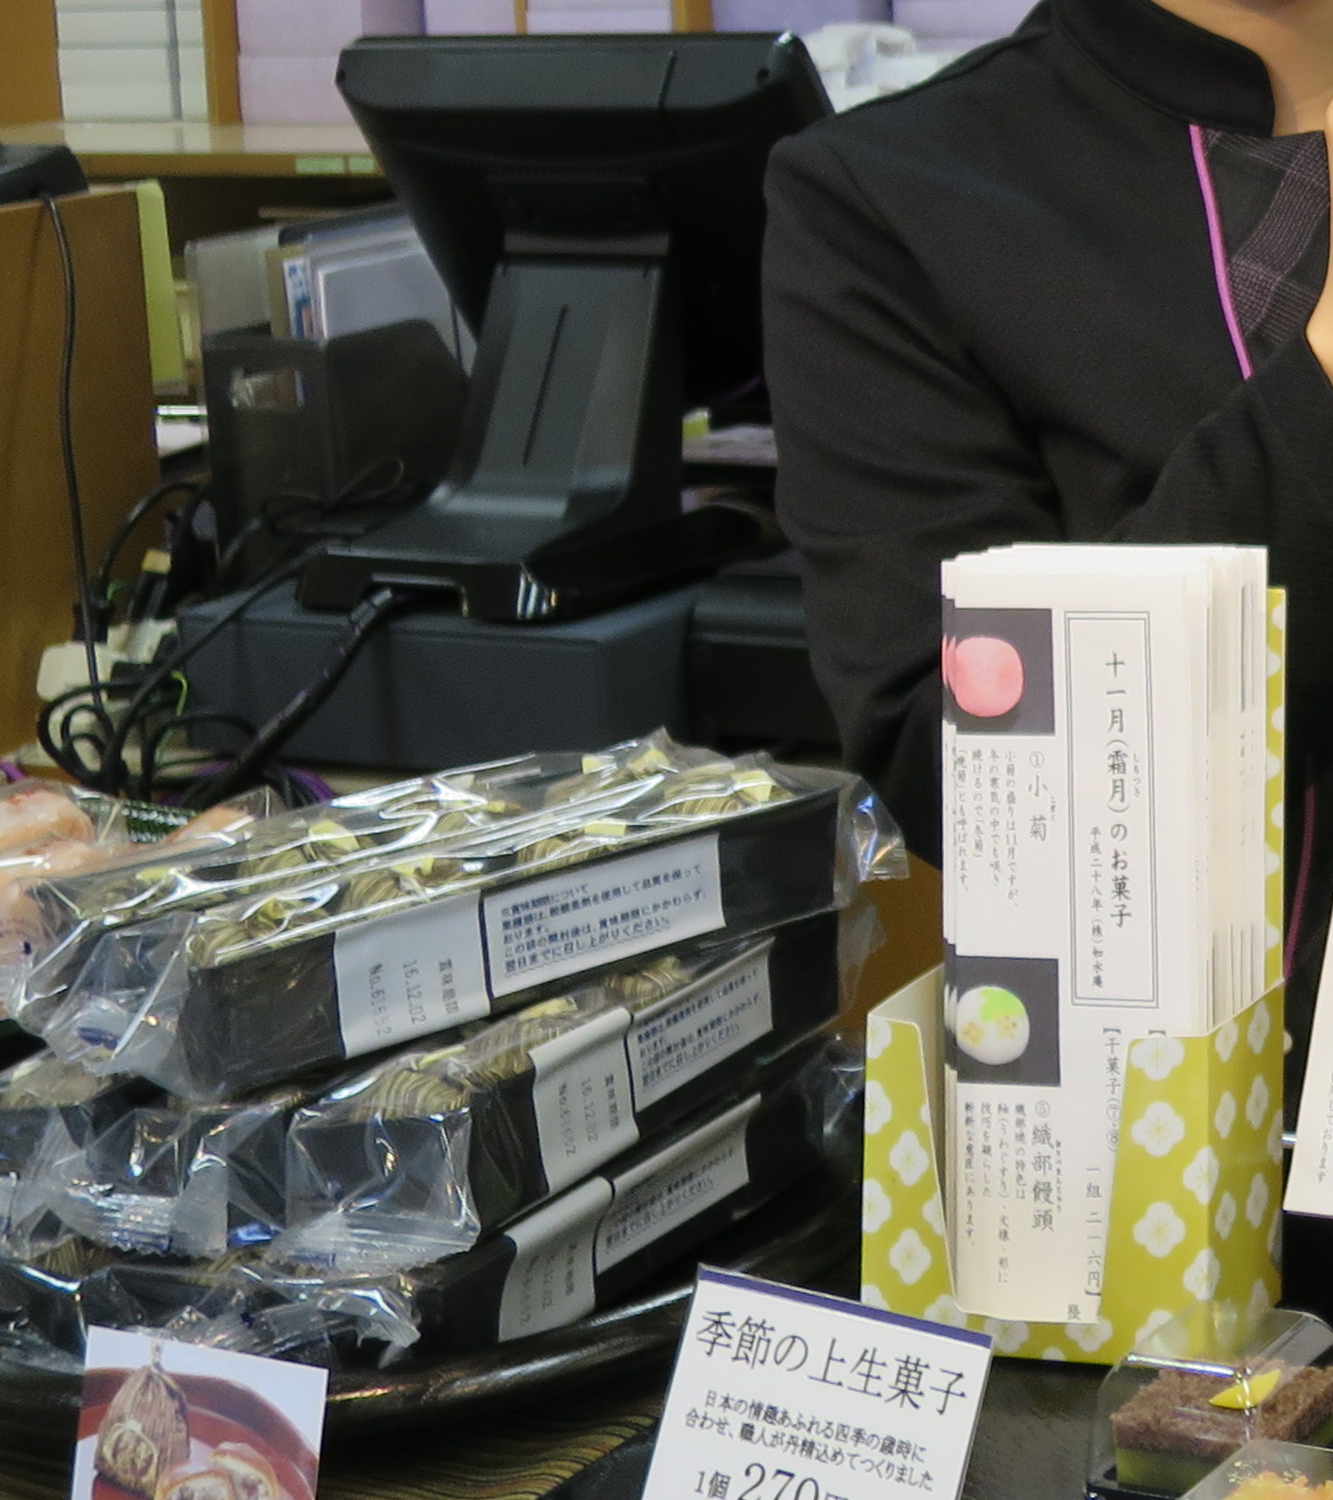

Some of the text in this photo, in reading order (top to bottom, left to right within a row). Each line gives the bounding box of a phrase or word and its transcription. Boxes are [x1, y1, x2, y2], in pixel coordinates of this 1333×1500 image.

[696, 1310, 968, 1417] 季節の上生菓子
[738, 1463, 849, 1500] 270
